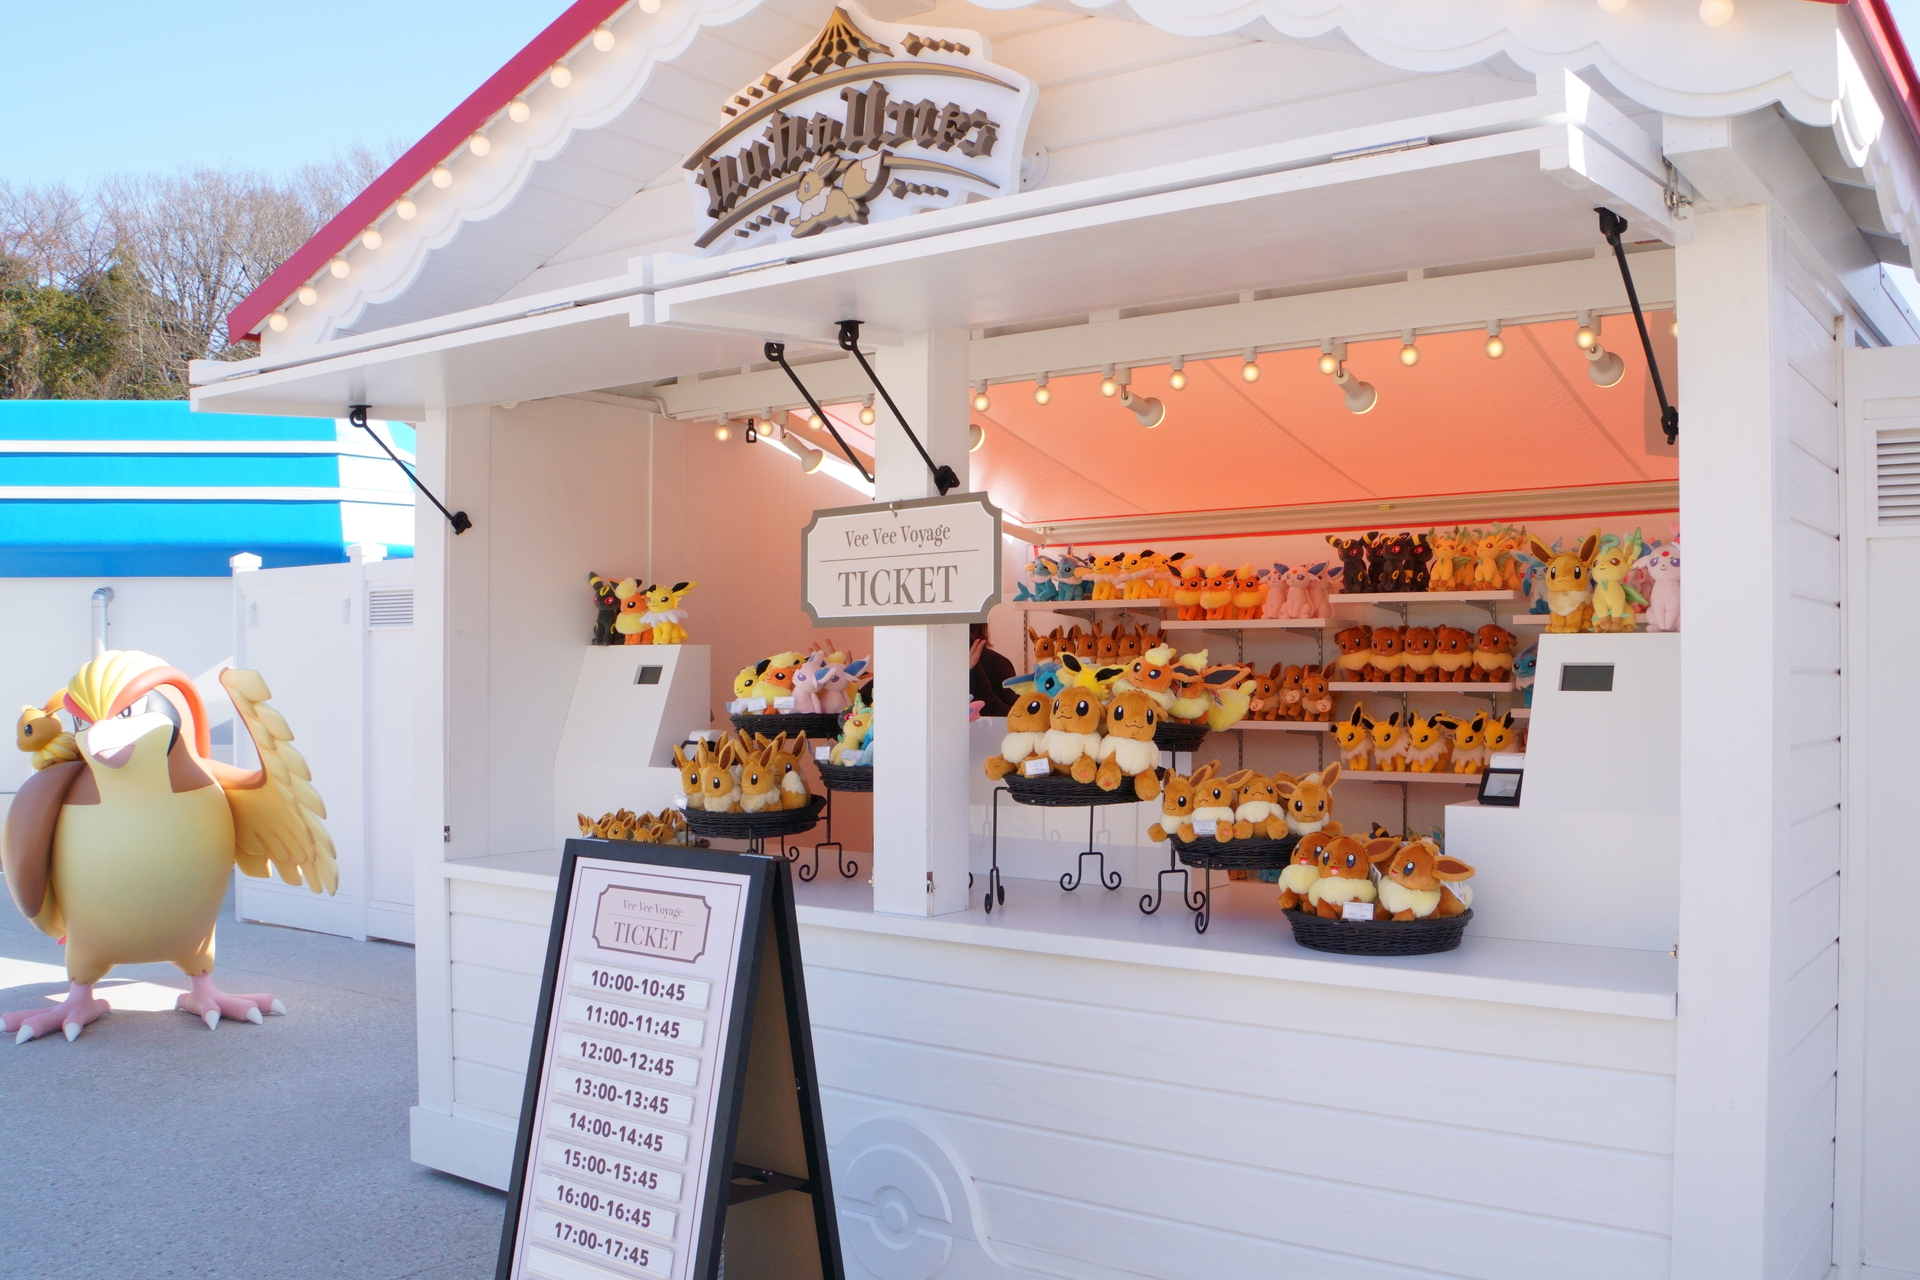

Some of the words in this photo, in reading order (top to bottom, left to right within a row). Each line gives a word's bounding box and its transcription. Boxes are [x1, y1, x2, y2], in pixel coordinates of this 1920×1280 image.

[845, 530, 869, 547] Vee
[872, 528, 897, 545] Vee
[900, 524, 951, 548] Voyage
[837, 565, 958, 607] TICKET
[623, 899, 638, 911] Vee
[639, 901, 653, 913] Vee
[655, 903, 683, 919] Voyage
[613, 921, 683, 951] TICKET
[591, 970, 686, 1001] 10:00-10:45
[586, 1005, 680, 1039] 11:00-11:45
[580, 1041, 674, 1077] 12:00-12:45
[574, 1077, 669, 1115] 13:00-13:45
[569, 1112, 663, 1152] 14:00-14:45
[564, 1149, 658, 1190] 15:00-15:45
[557, 1184, 651, 1228] 16:00-16:45
[555, 1221, 649, 1267] 17:00-17:45
